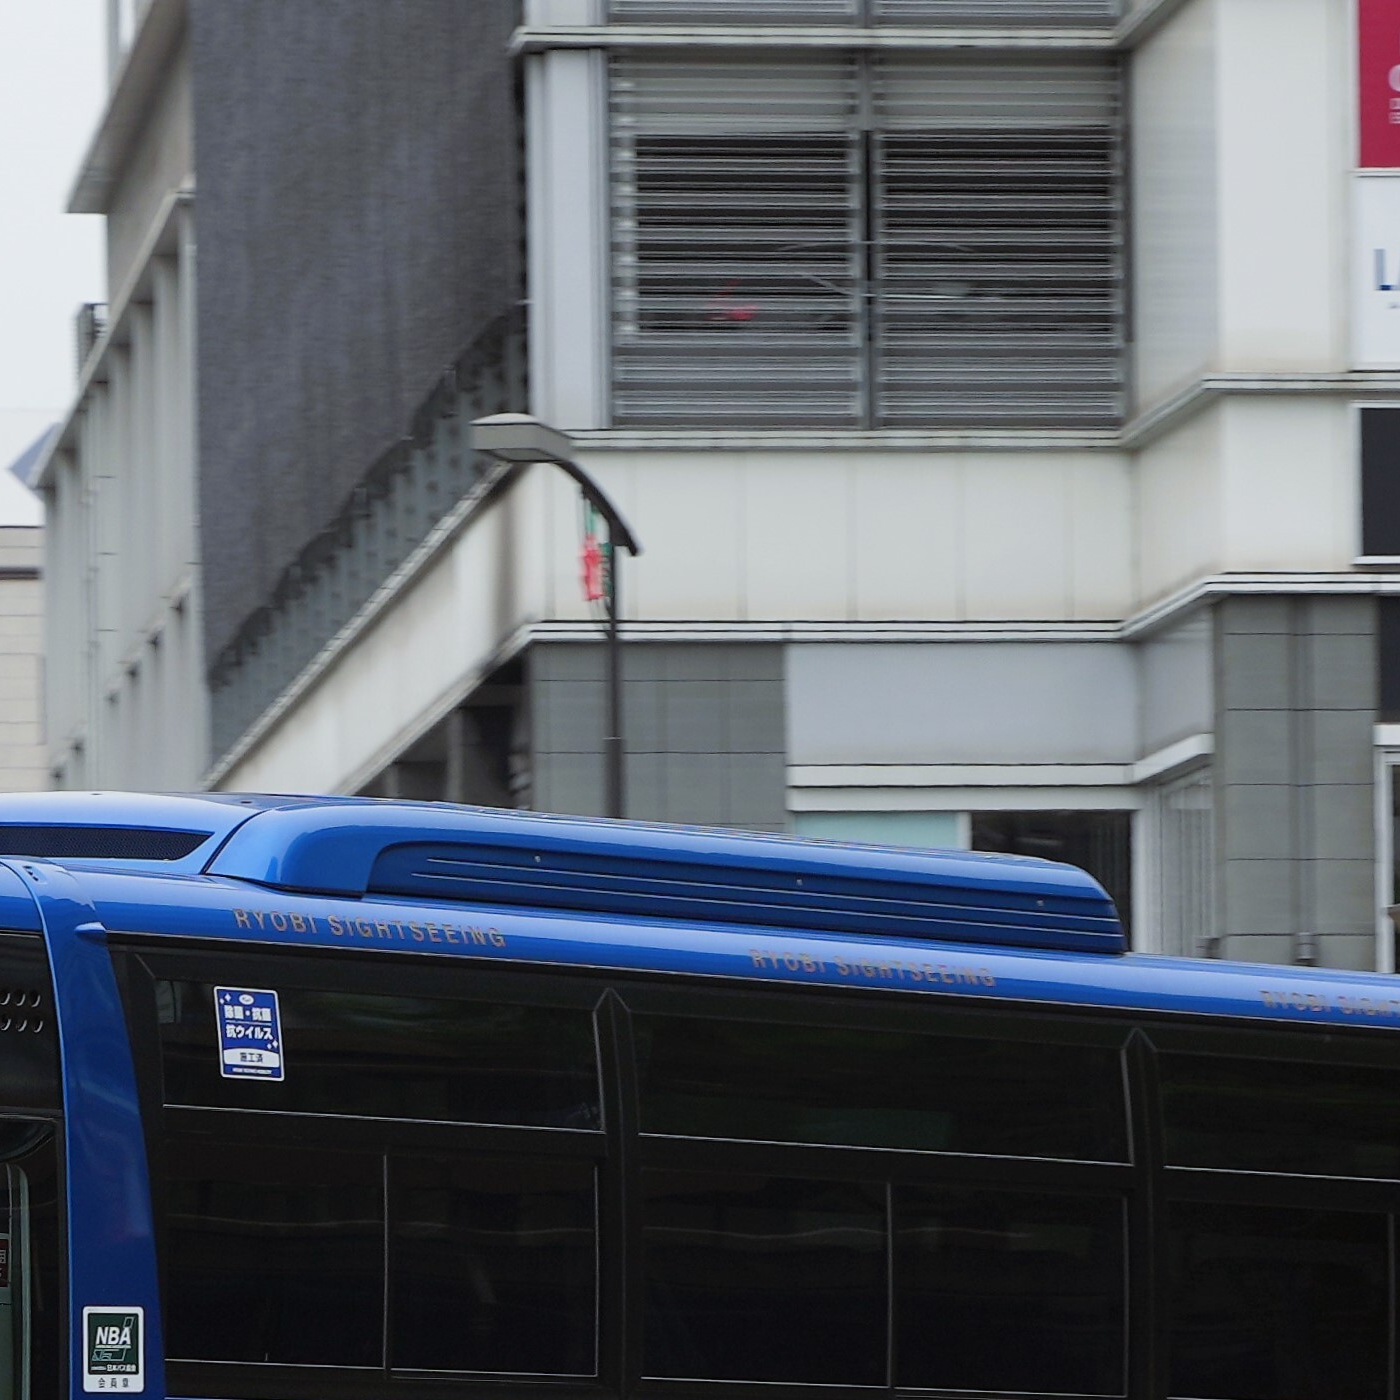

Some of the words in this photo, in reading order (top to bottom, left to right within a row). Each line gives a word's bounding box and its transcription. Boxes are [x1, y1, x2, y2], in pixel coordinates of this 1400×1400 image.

[233, 907, 317, 935] RYOBI
[326, 913, 506, 948] SIGHTSEEING
[749, 948, 826, 974] RYOBI
[833, 954, 997, 988] SIGHTSEEING
[225, 1024, 274, 1040] 抗ウイルス
[95, 1326, 132, 1345] NBA
